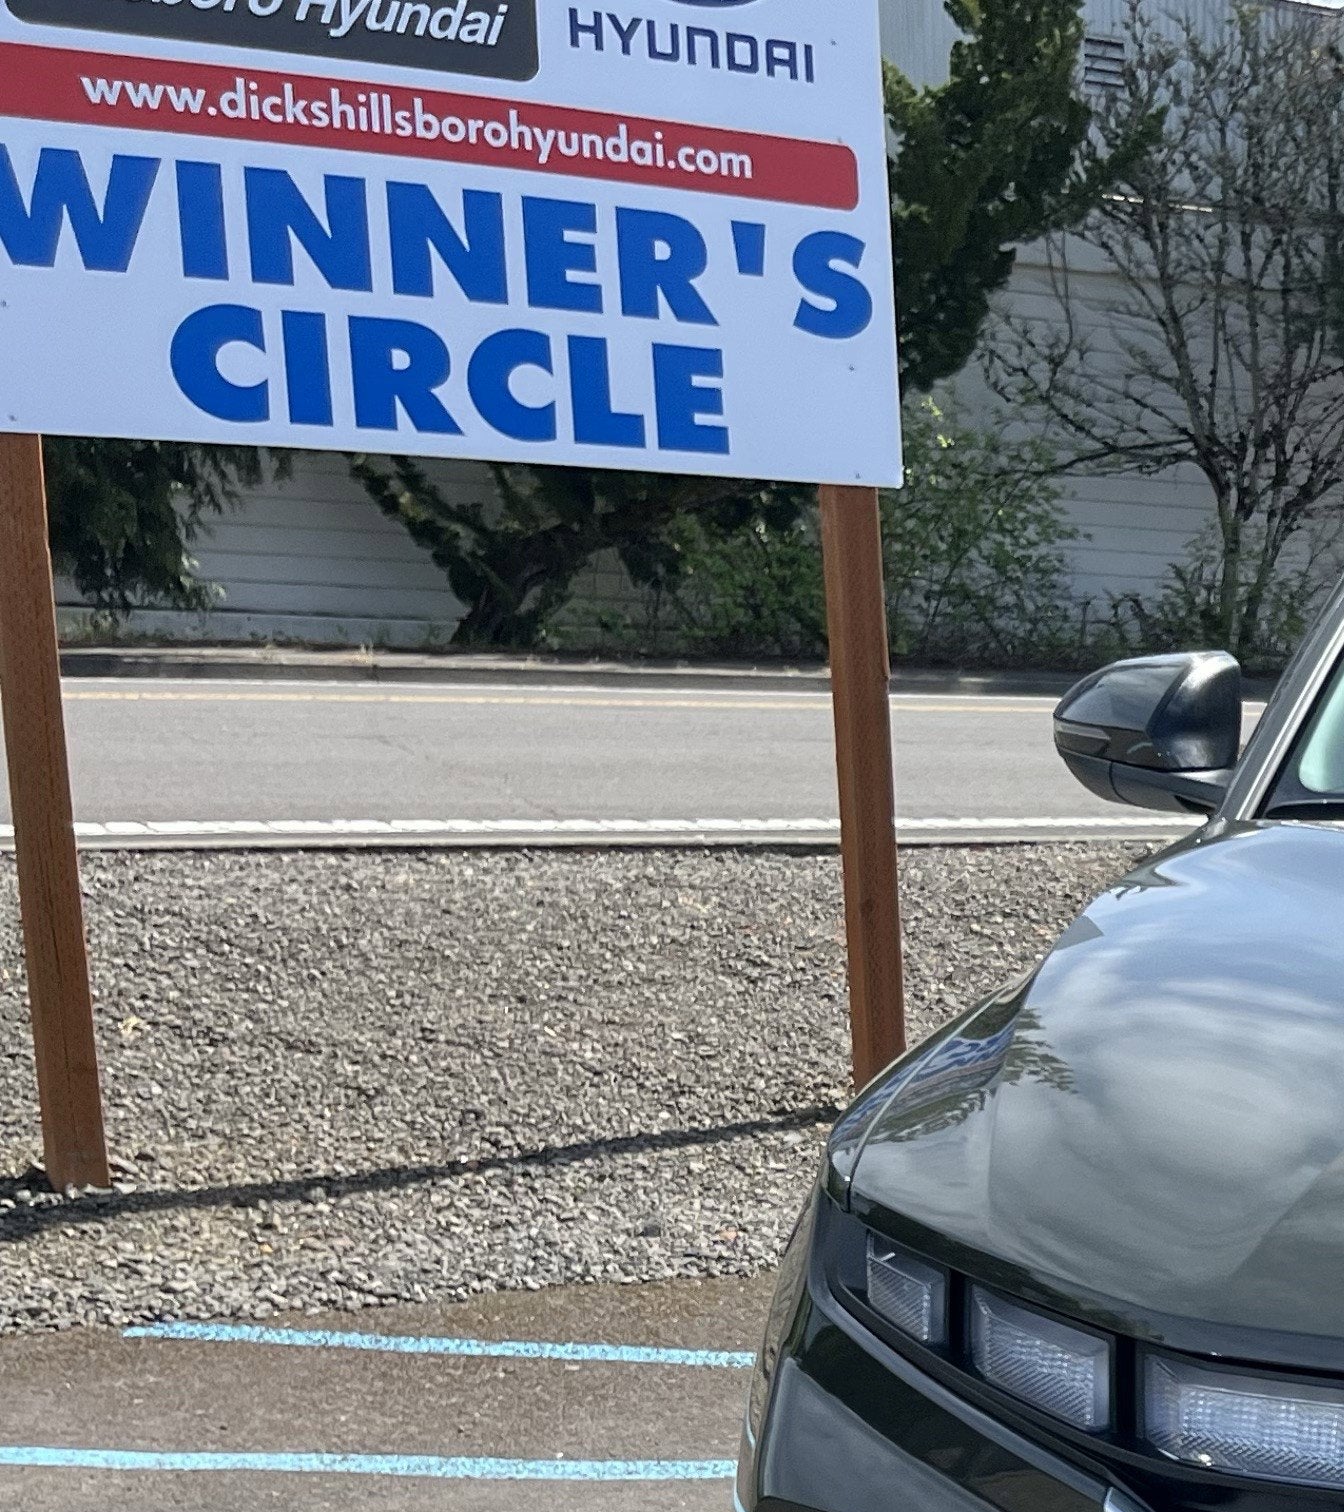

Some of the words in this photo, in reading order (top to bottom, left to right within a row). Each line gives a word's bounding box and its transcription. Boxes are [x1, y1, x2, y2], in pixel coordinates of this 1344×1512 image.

[296, 0, 509, 46] Hyundai
[568, 7, 816, 84] HYUNDAI
[80, 74, 754, 180] www.dickshillsborohyundai.com
[0, 142, 873, 340] WINNER'S
[169, 303, 731, 456] CIRCLE
